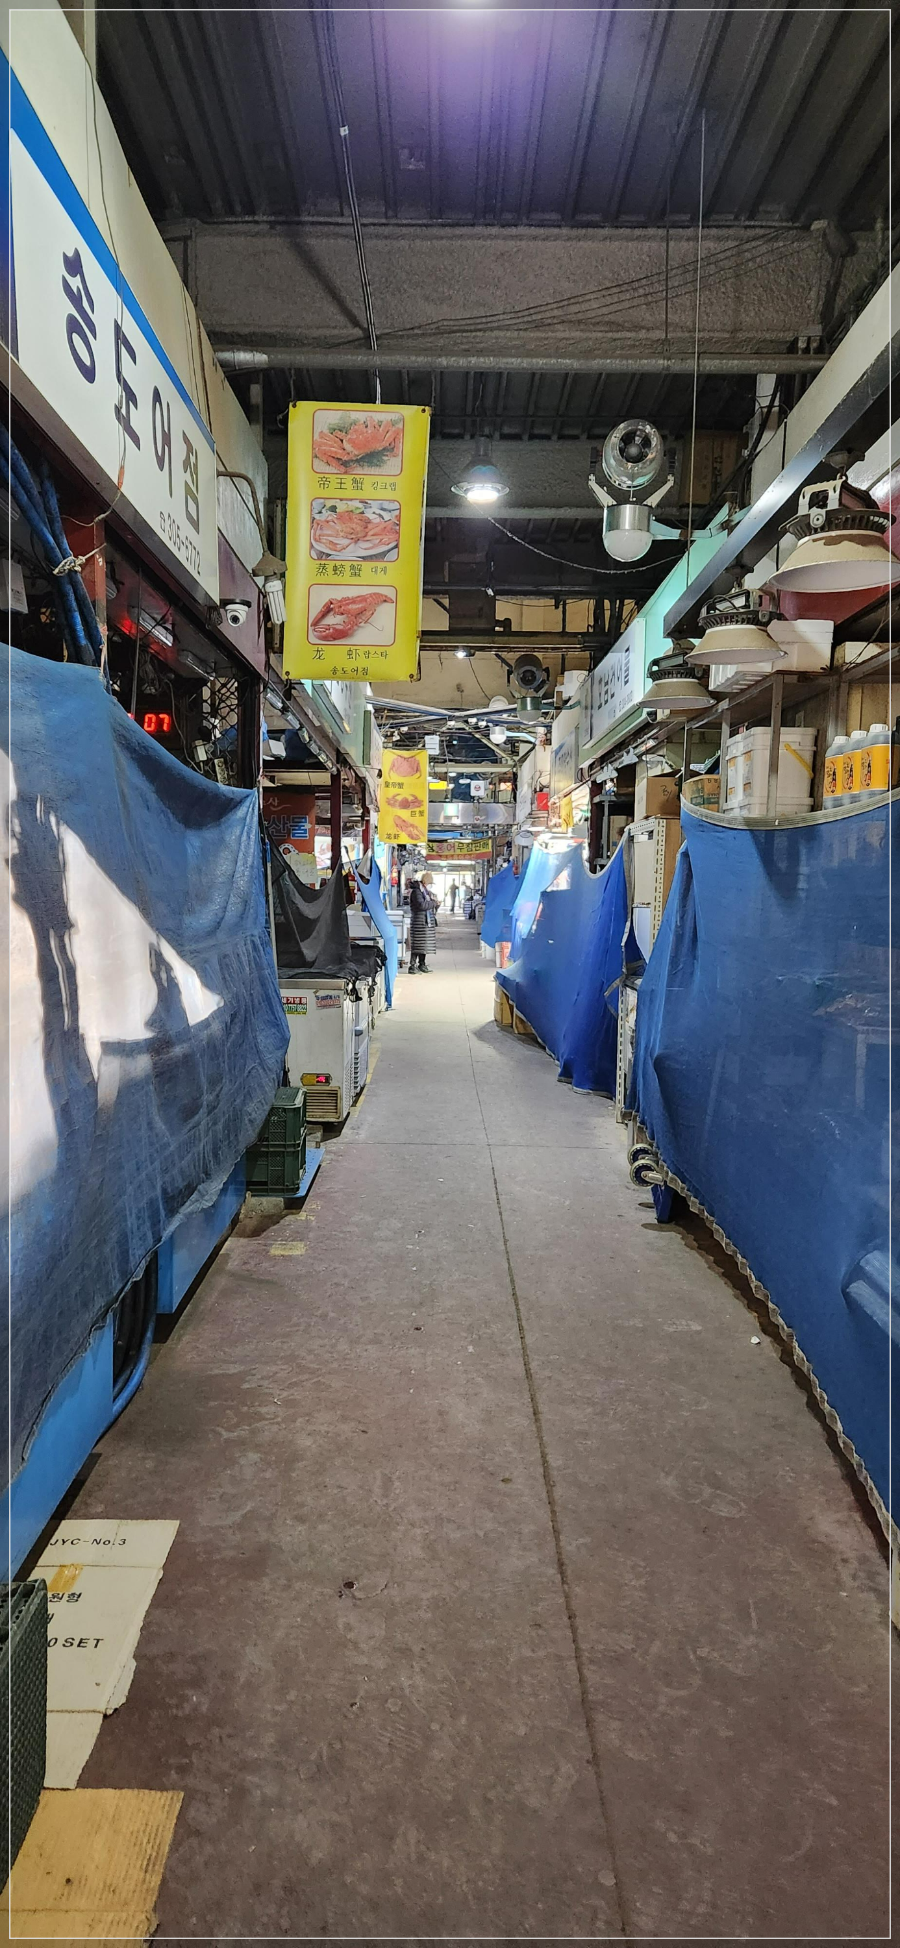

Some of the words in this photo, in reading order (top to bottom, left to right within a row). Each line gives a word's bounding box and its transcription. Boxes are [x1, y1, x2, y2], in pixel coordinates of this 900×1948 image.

[62, 247, 199, 535] 송도어점
[318, 476, 365, 491] 帝王蟹
[371, 481, 397, 491] 킹크랩
[168, 512, 201, 576] 305-6772
[315, 562, 363, 577] 蒸螃蟹
[371, 565, 388, 576] 대게
[330, 666, 369, 676] 송도어점
[62, 1637, 103, 1648] SET
